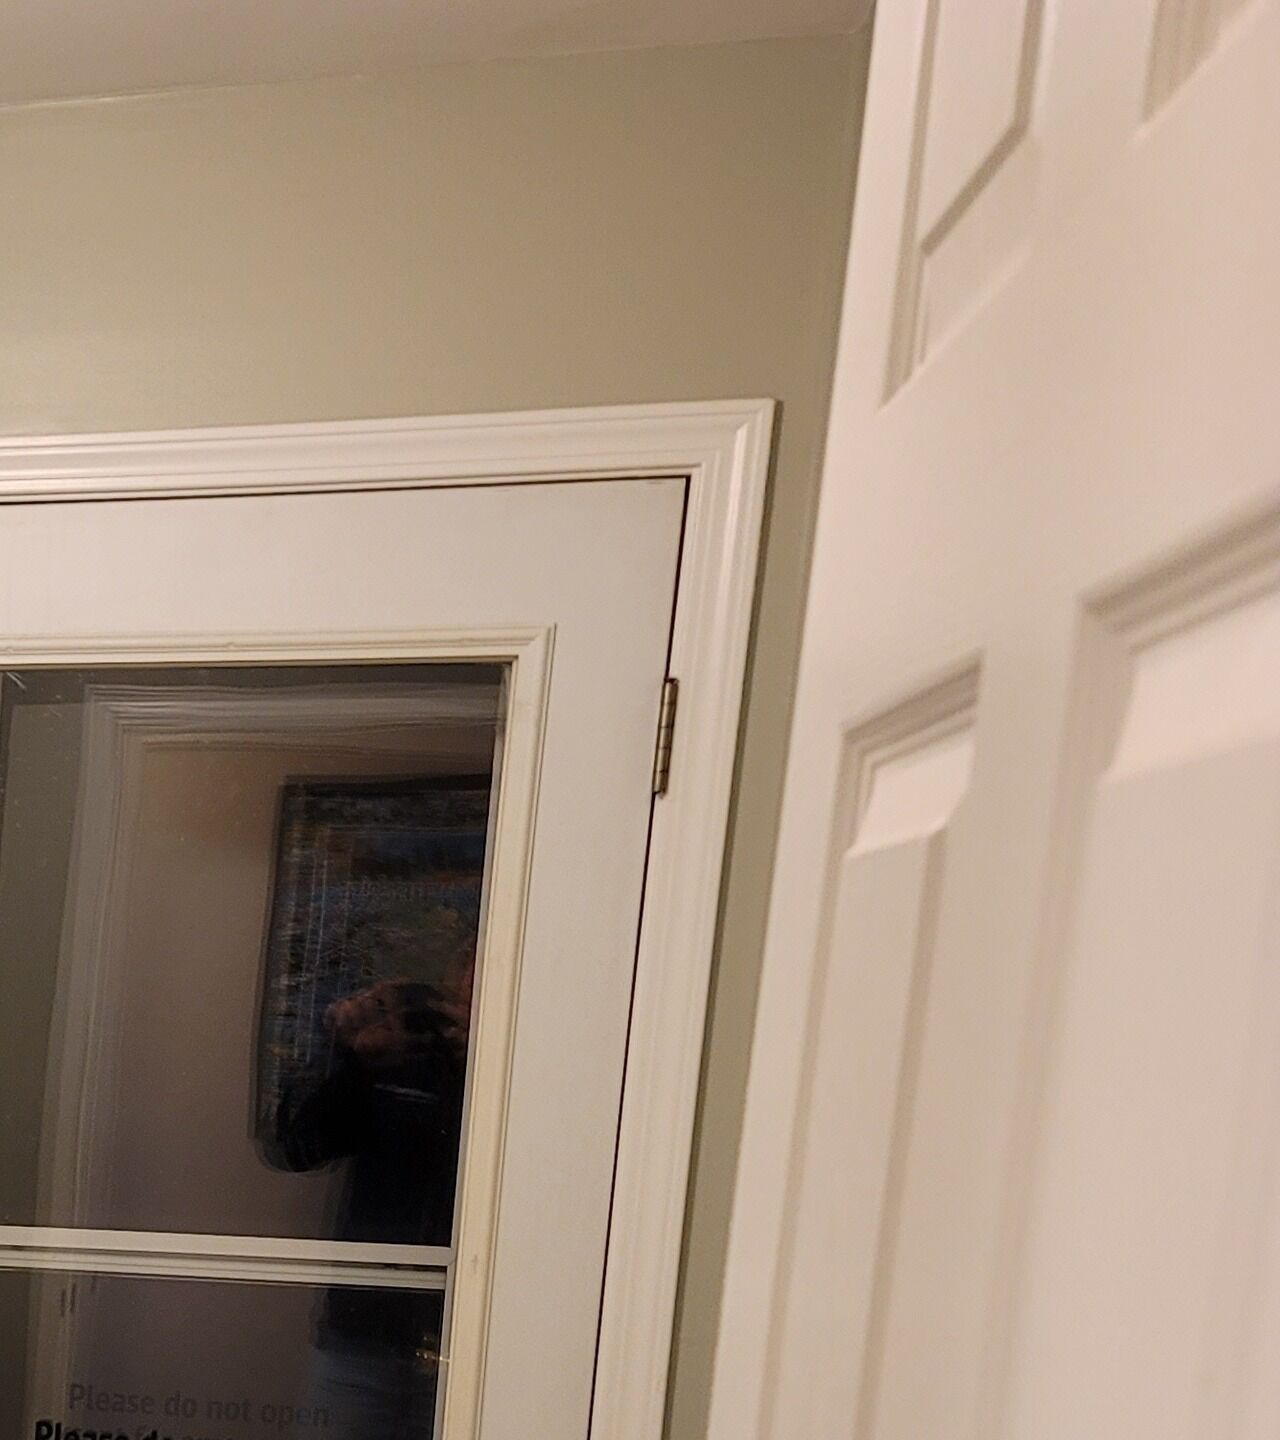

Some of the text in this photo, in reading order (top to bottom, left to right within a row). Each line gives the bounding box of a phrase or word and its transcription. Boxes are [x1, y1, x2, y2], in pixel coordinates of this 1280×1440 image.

[68, 1383, 330, 1428] Please do not open
